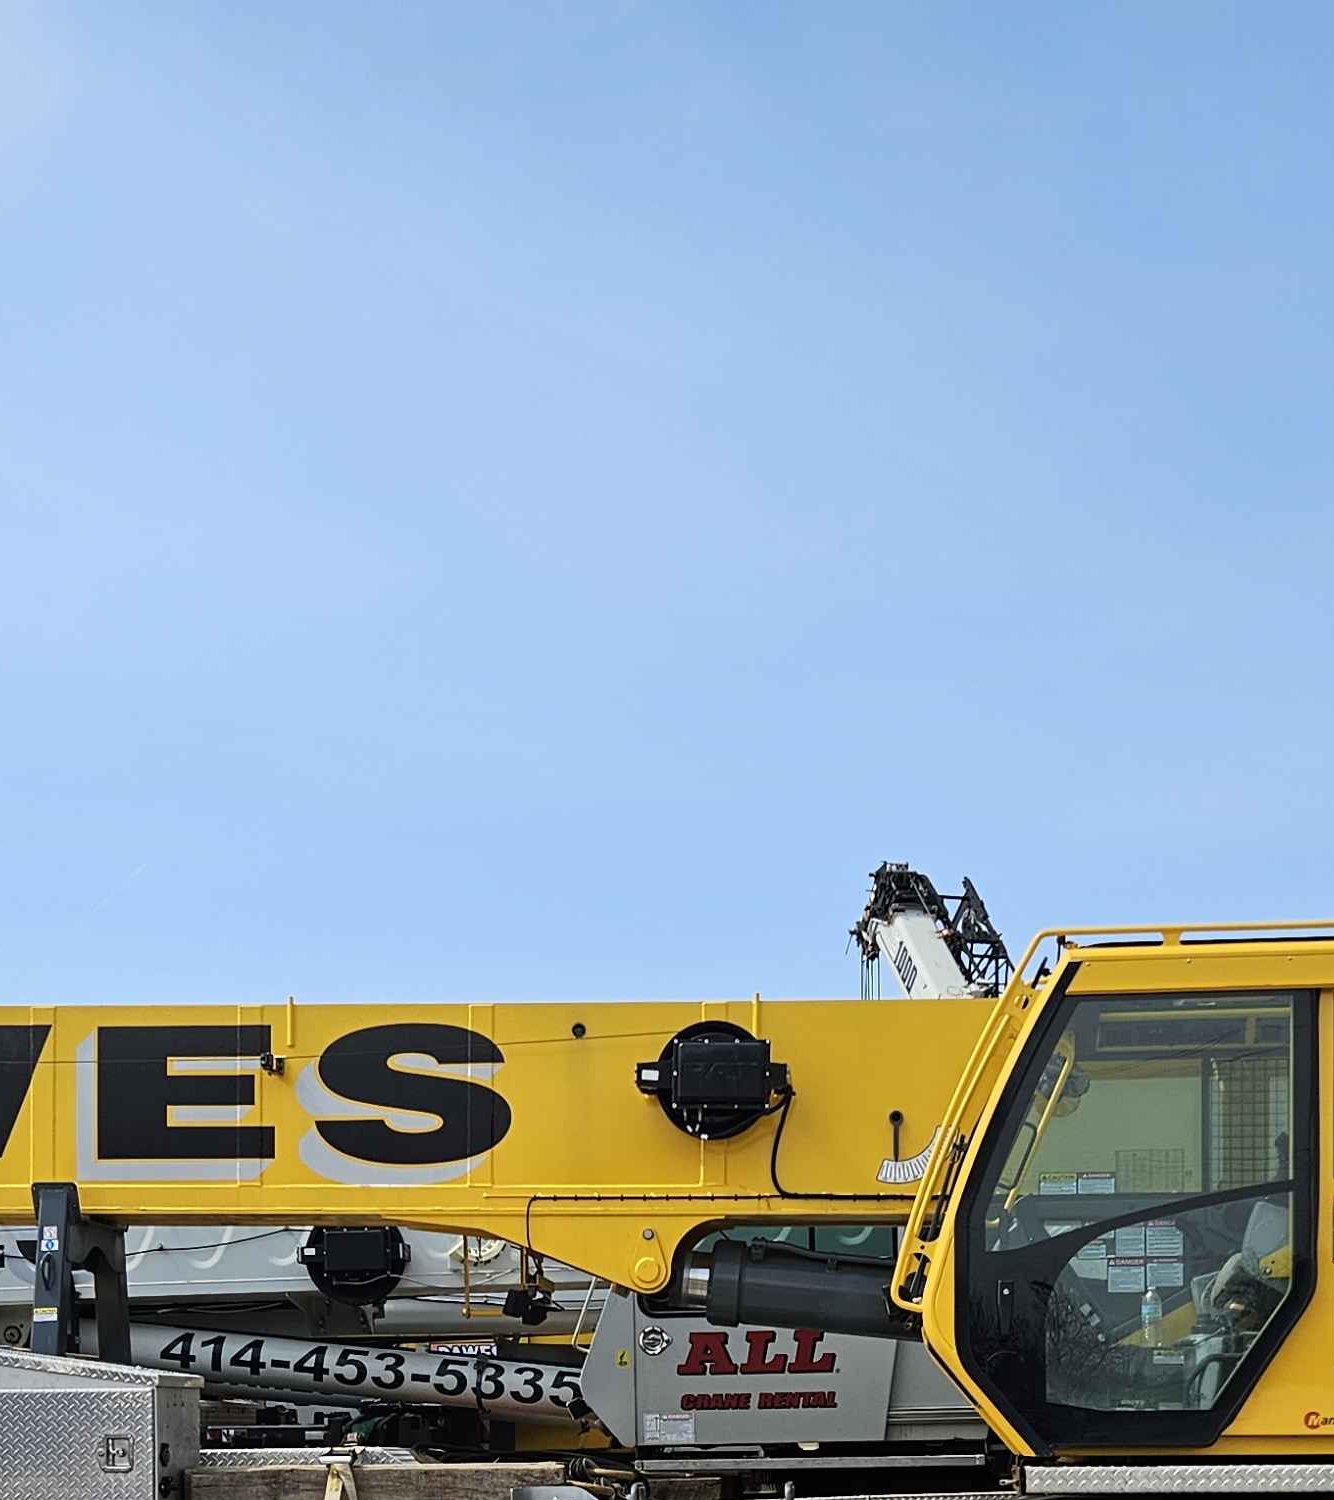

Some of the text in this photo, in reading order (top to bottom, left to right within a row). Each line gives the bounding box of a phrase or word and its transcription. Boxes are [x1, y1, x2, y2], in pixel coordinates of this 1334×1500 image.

[160, 1331, 584, 1409] 414-453-5335
[677, 1329, 836, 1375] ALL
[681, 1391, 838, 1411] CRANE RENTAL
